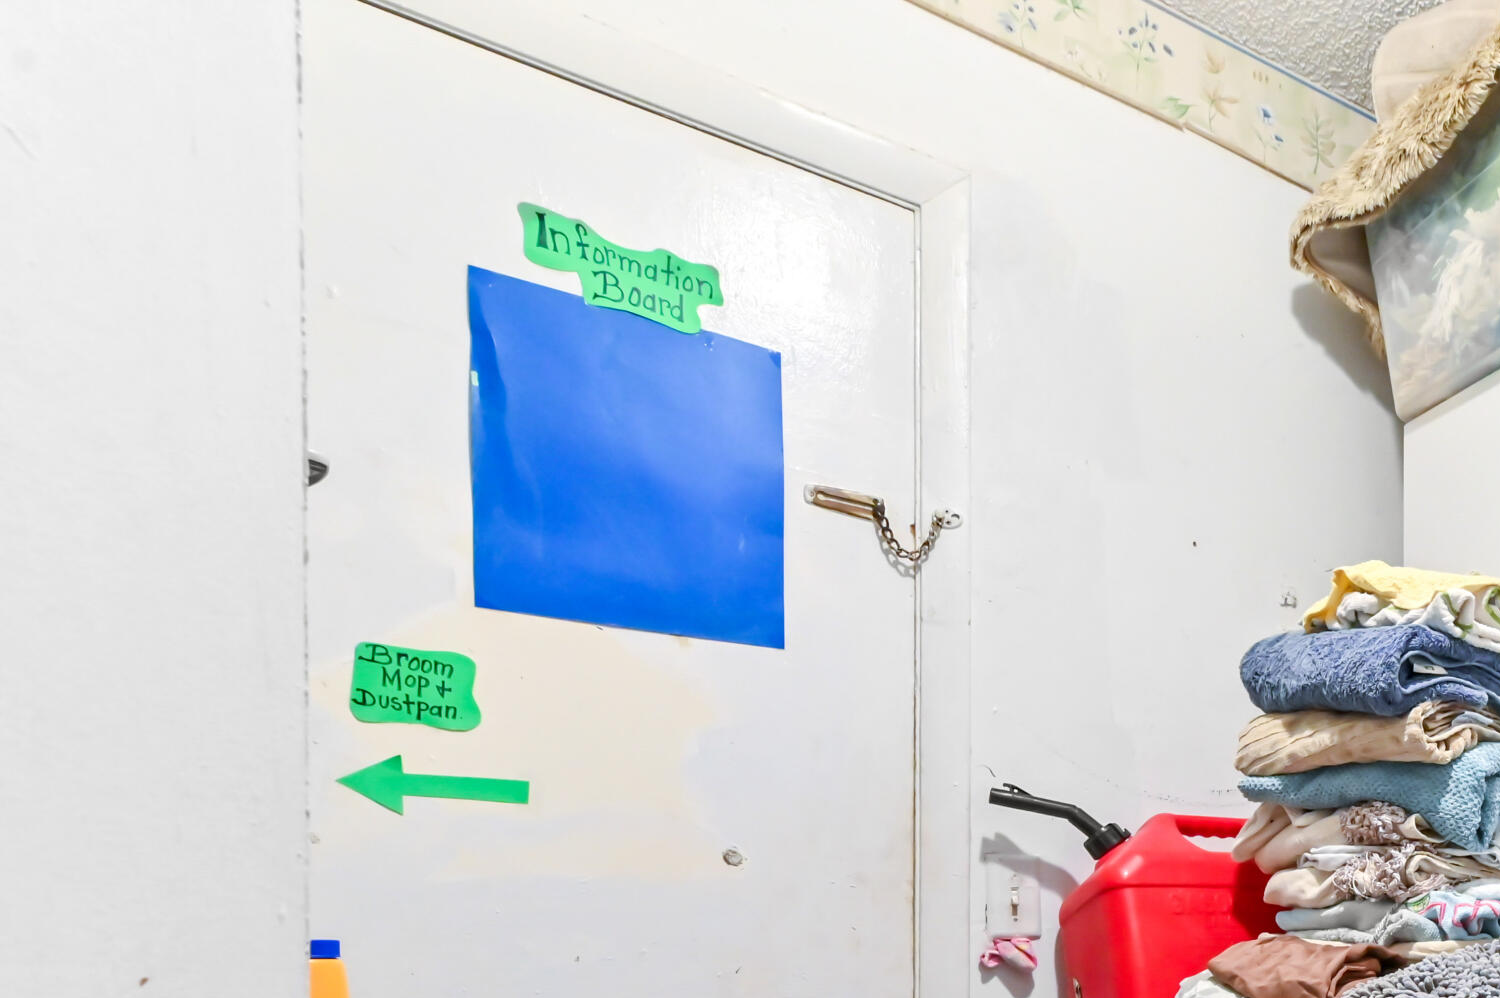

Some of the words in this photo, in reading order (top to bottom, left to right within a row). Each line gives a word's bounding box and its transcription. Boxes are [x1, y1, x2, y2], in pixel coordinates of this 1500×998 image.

[535, 211, 713, 299] Information
[592, 270, 685, 323] Board
[358, 643, 454, 678] Broom
[381, 666, 430, 698] Mop
